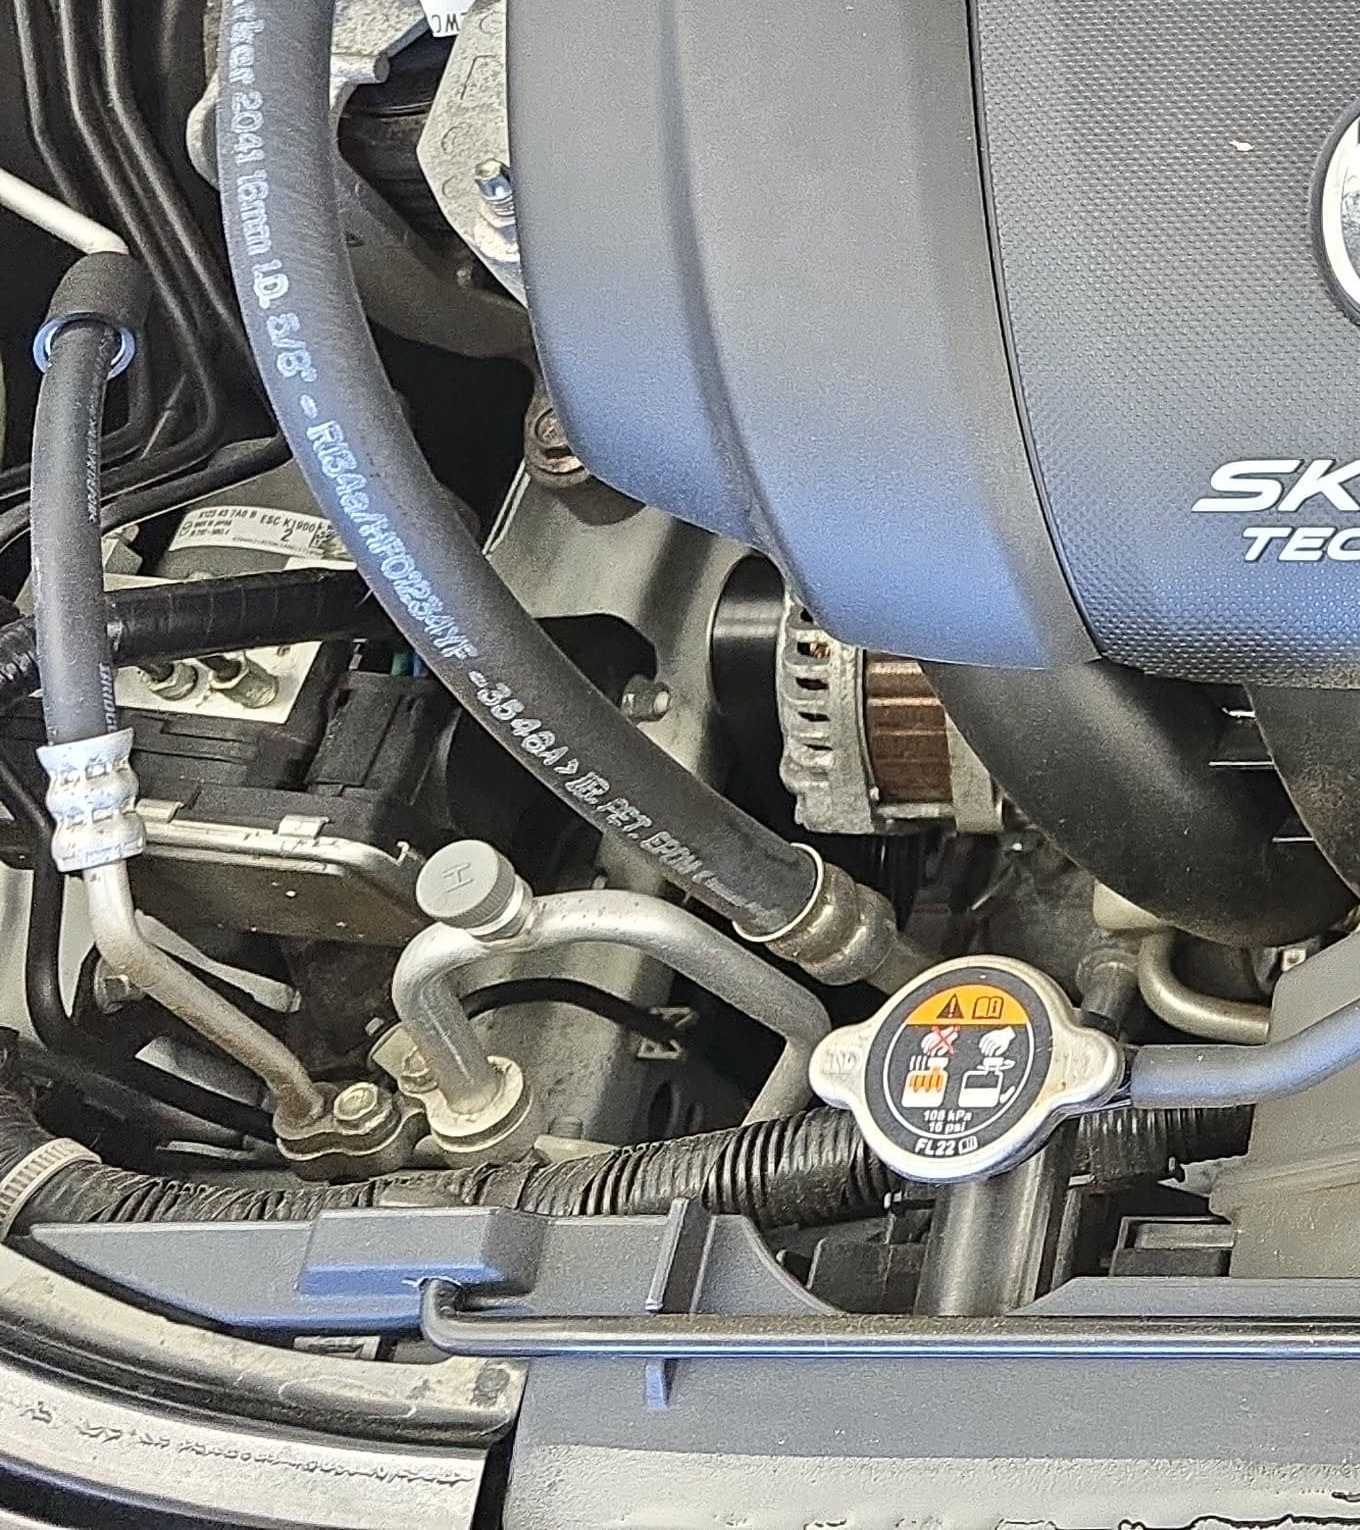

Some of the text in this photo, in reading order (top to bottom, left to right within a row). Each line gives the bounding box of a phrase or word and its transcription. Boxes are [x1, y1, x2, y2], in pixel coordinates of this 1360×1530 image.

[231, 95, 264, 166] 2041
[236, 169, 272, 259] 16mm
[260, 514, 282, 526] ESC
[281, 528, 293, 542] 2
[948, 1108, 972, 1122] kPa
[928, 1121, 966, 1134] 16 psi
[915, 1137, 956, 1155] FL22
